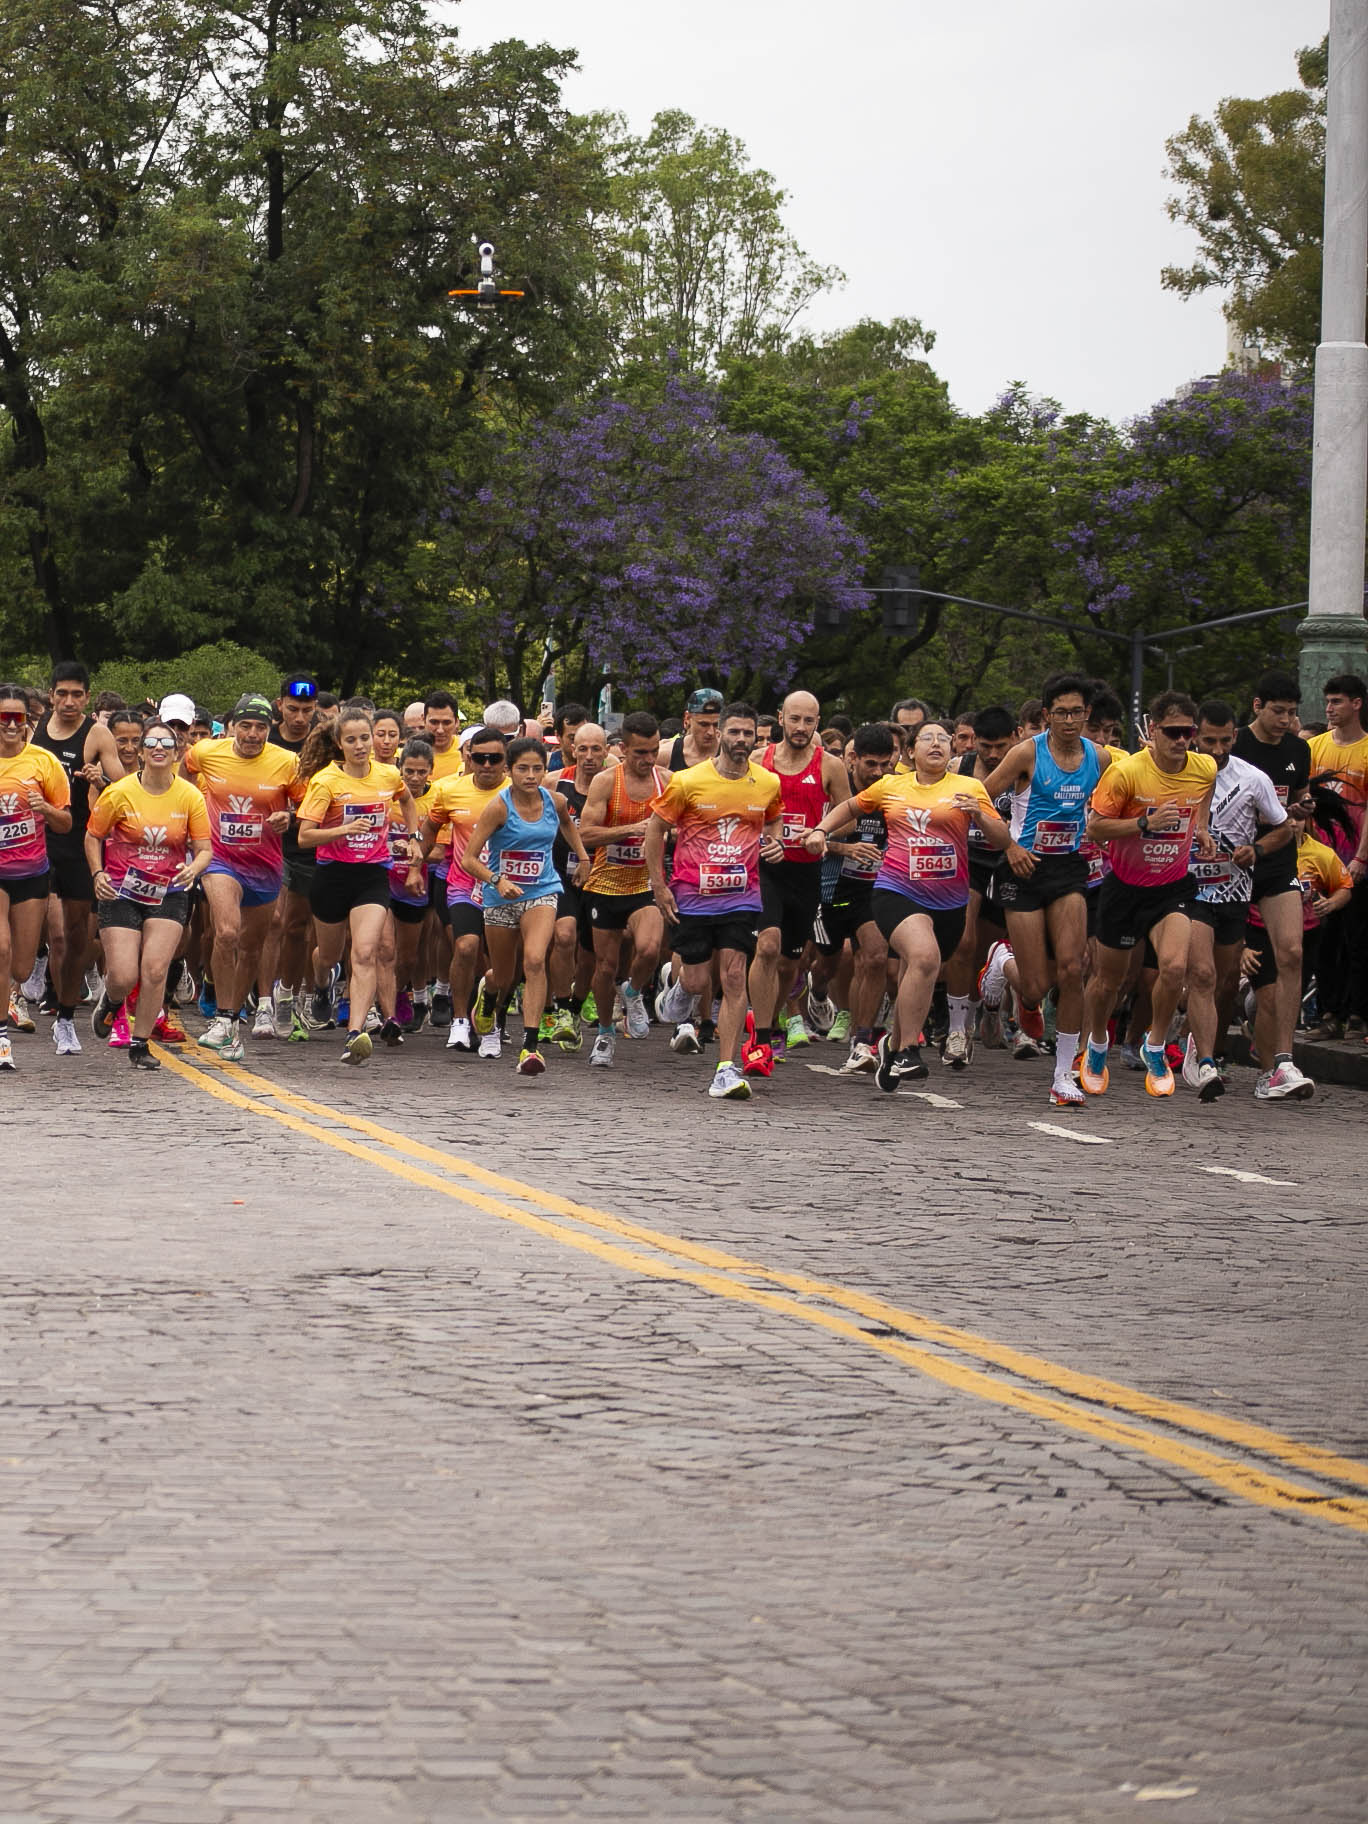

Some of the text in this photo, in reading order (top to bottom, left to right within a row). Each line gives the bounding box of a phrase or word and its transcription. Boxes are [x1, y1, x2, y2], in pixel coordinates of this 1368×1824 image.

[3, 823, 28, 839] 226
[228, 824, 253, 837] 845
[1041, 833, 1072, 846] 5734
[616, 847, 640, 858] 145
[1143, 844, 1179, 855] COPA
[506, 861, 539, 875] 5159
[916, 857, 952, 870] 5643
[1194, 865, 1221, 877] 163
[132, 880, 157, 896] 241
[707, 876, 742, 888] 5310
